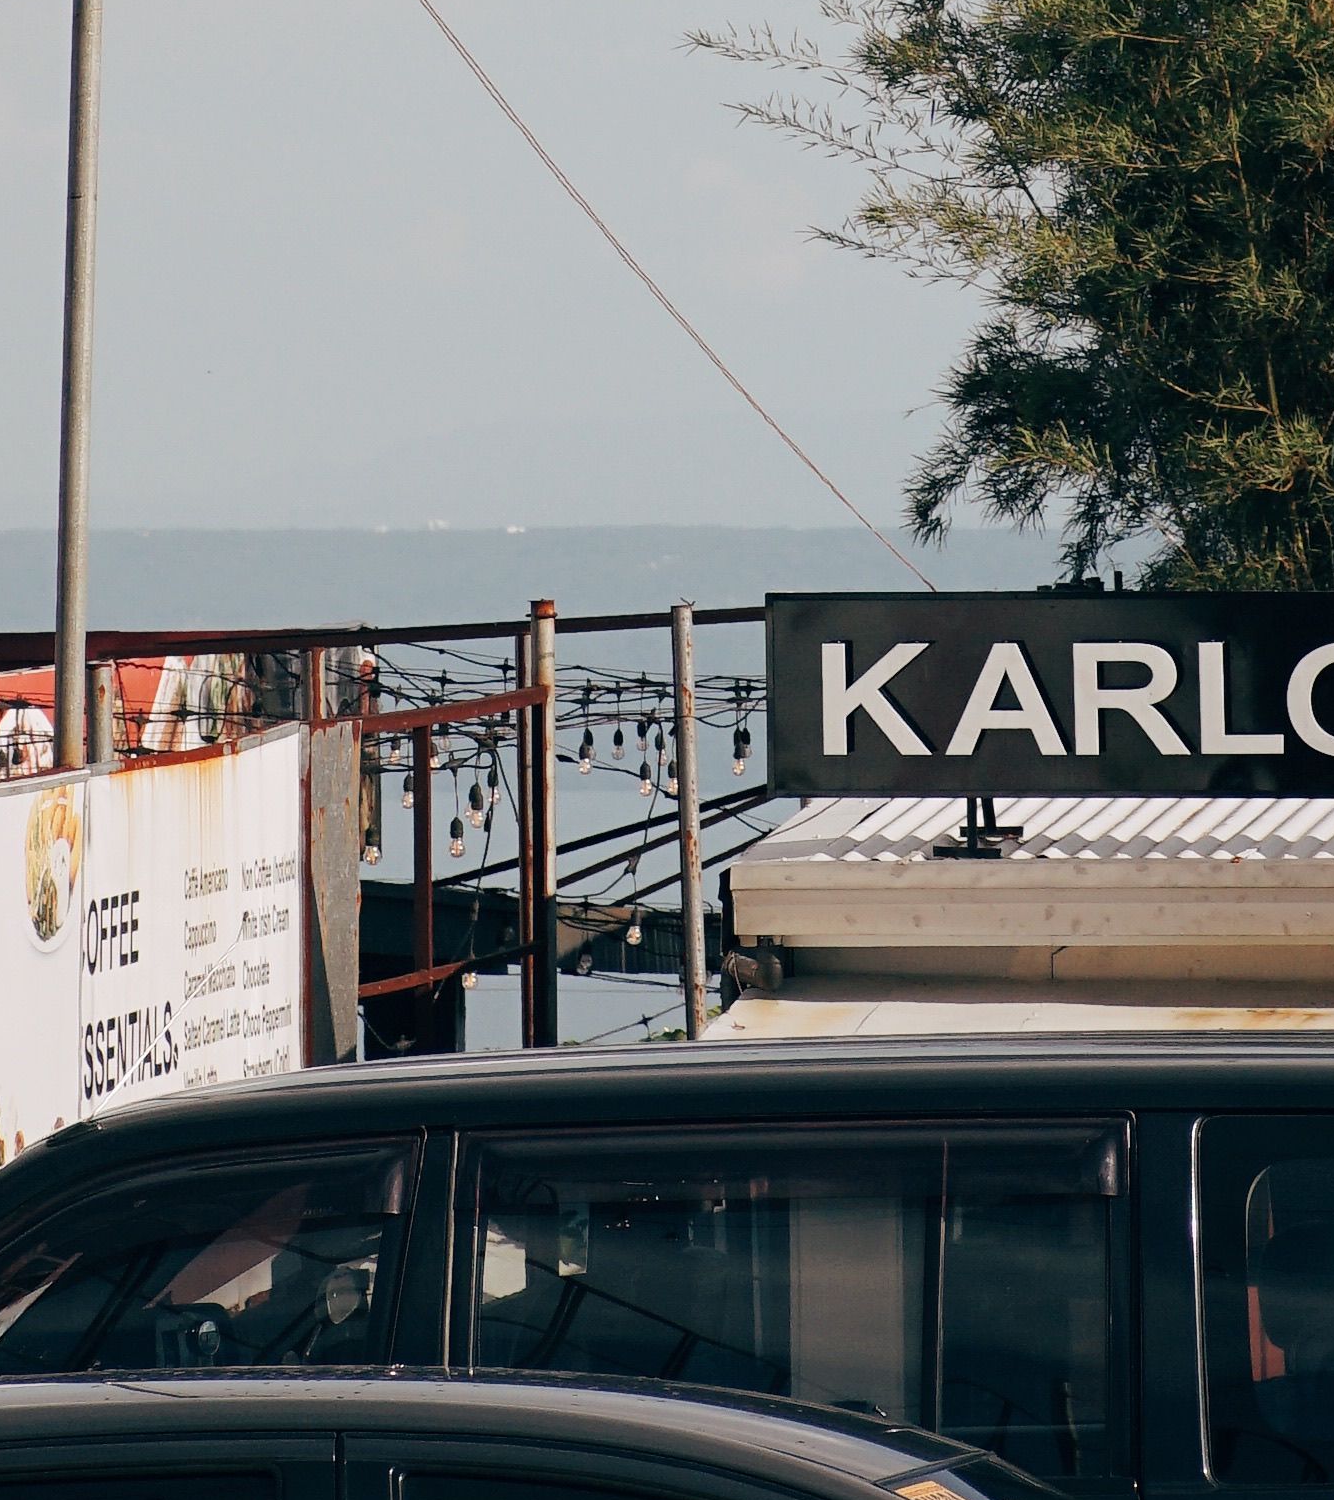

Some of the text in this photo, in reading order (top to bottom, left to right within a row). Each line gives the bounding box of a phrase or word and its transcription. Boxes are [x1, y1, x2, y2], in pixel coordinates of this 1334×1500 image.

[242, 862, 252, 891] Non
[254, 858, 271, 889] Coffee
[82, 890, 139, 976] OFFEE
[272, 904, 289, 933] Cream
[243, 956, 270, 990] Chocolate
[203, 1008, 225, 1045] Caramel
[227, 1008, 240, 1038] Latte
[243, 1009, 261, 1038] Choco
[83, 1000, 172, 1099] SSENTIALS
